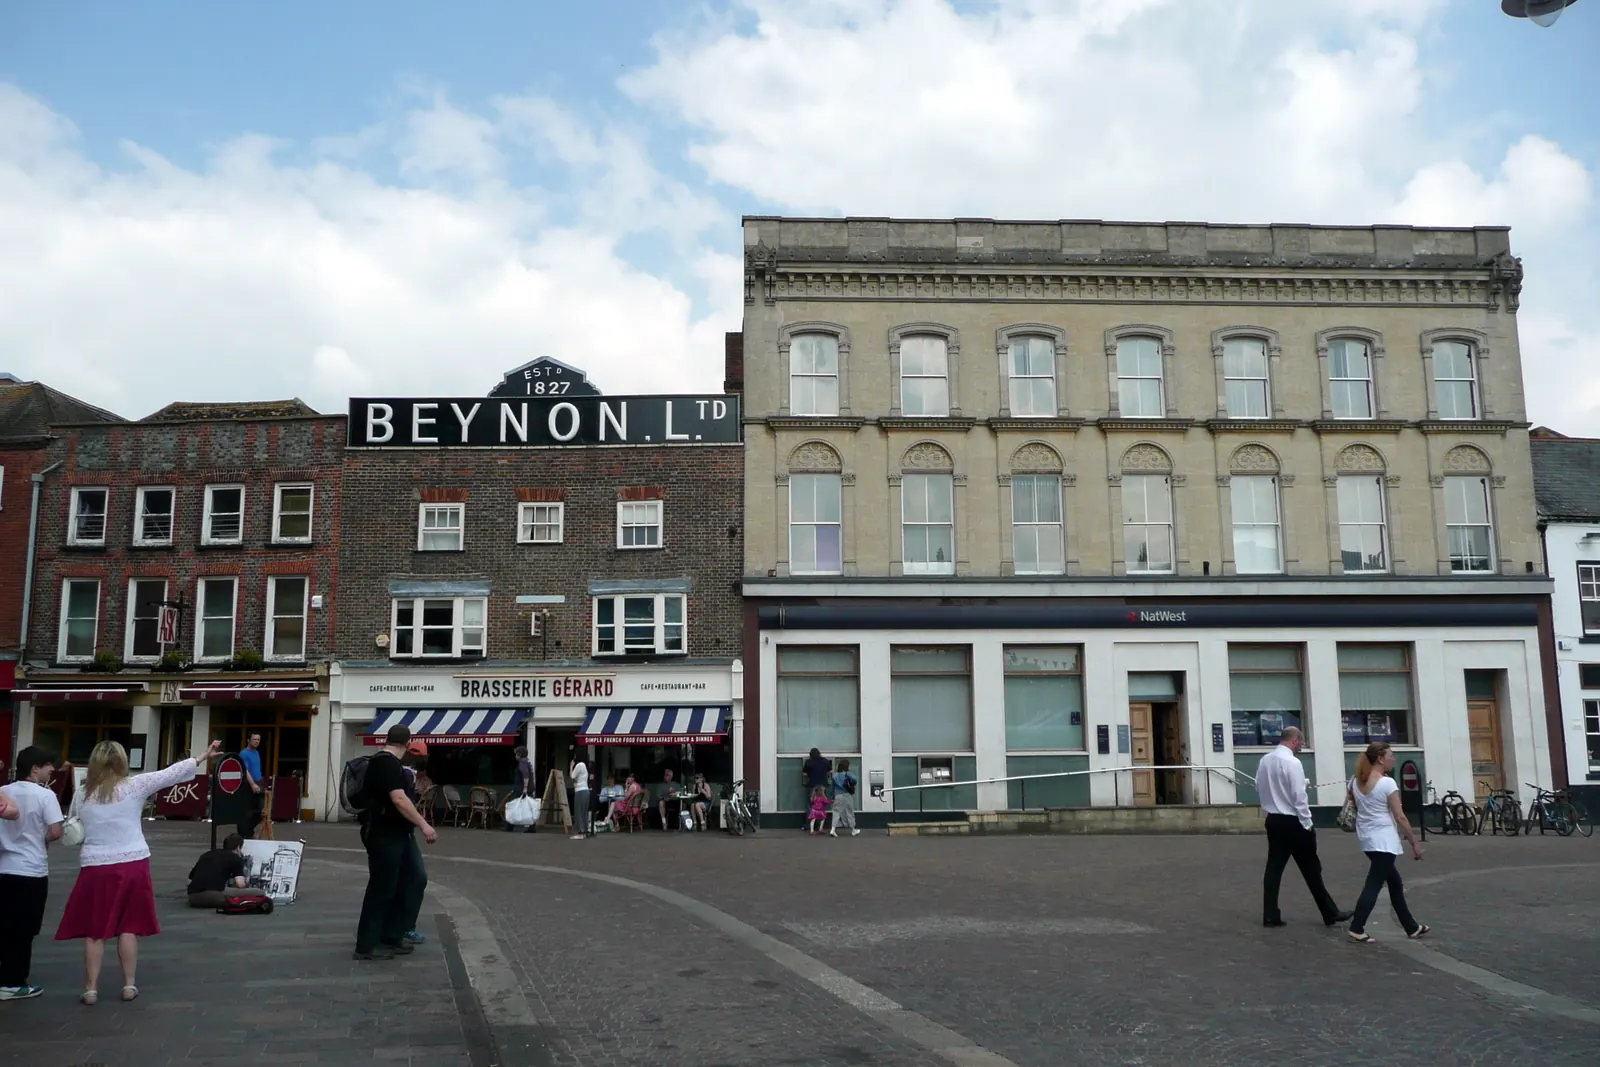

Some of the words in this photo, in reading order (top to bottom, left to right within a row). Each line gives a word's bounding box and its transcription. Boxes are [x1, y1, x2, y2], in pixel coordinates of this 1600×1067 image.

[524, 366, 563, 380] ESTD
[526, 381, 571, 395] 1827
[160, 609, 177, 642] ASK
[1140, 611, 1187, 622] NatWest
[163, 681, 179, 702] ASK
[460, 679, 547, 697] BRASSERIE
[552, 676, 614, 697] GÉRARD
[163, 783, 200, 804] ASK
